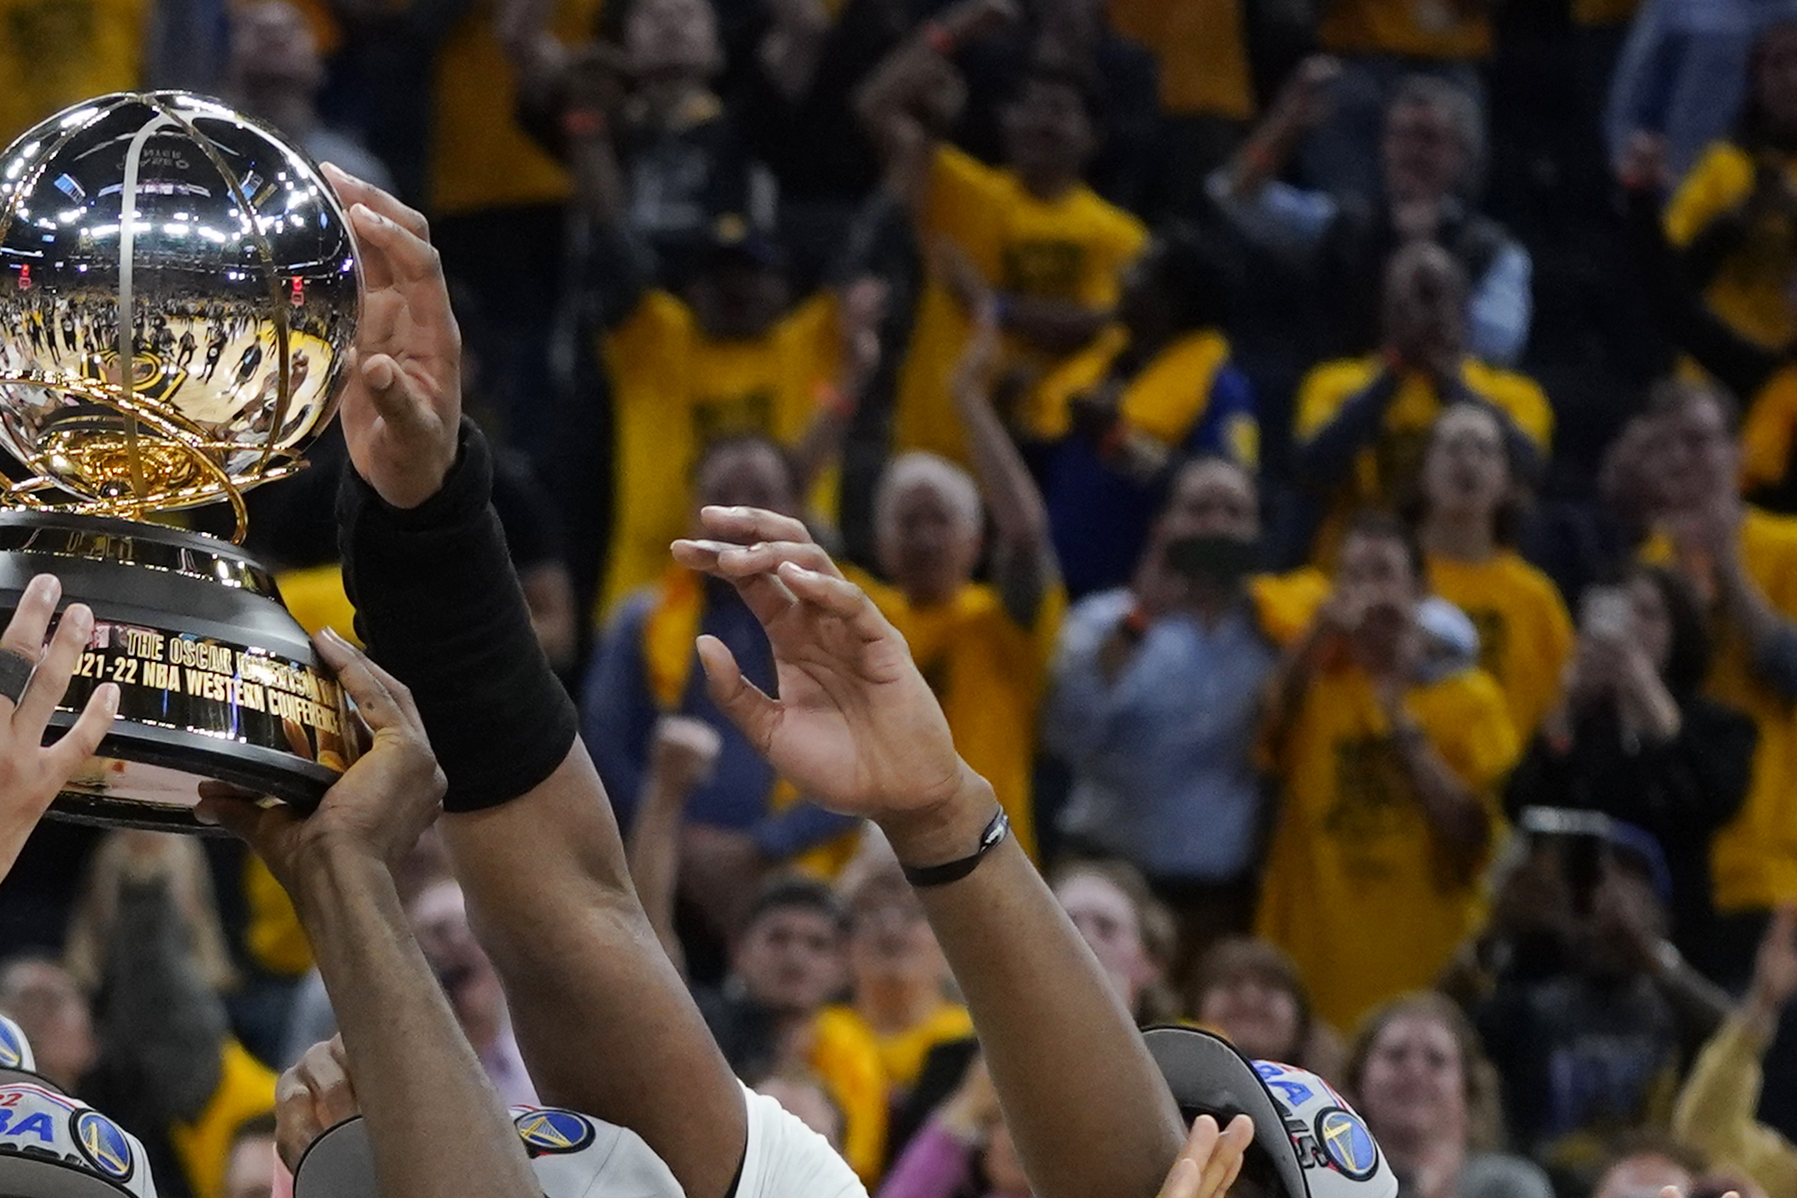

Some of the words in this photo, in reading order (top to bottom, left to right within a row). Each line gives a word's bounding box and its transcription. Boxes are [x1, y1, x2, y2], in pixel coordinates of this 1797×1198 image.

[127, 628, 165, 661] THE
[169, 637, 234, 676] OSCAR
[142, 660, 181, 694] NBA
[185, 668, 266, 712] WESTERN
